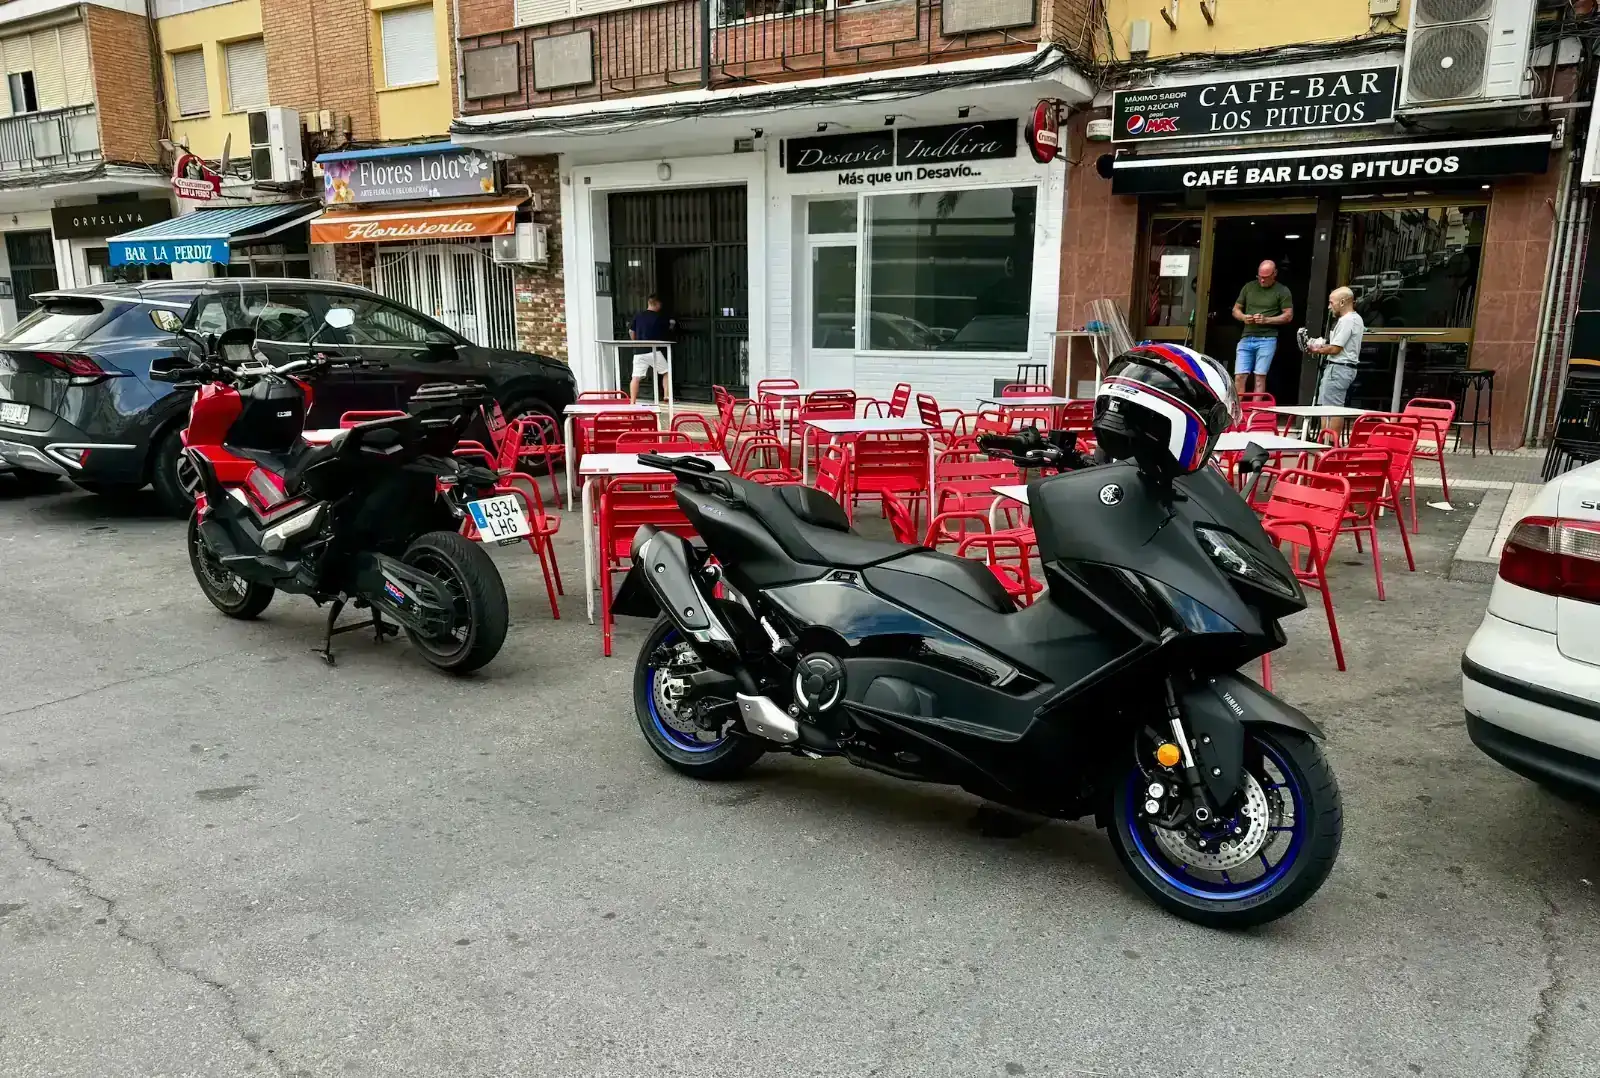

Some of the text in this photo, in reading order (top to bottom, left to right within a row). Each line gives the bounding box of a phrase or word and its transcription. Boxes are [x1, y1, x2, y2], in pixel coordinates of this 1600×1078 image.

[1124, 91, 1187, 103] MÁXIMO SABOR
[1199, 72, 1382, 107] CAFE-BAR
[1124, 102, 1180, 113] ZERO AZÚCAR
[1209, 101, 1365, 132] LOS PITUFOS
[1144, 116, 1180, 133] MAX
[796, 124, 1002, 167] Desavío Indhira
[360, 154, 460, 186] Flores Lola
[838, 164, 982, 187] Más que un Desavío...
[1182, 155, 1460, 188] CAFÉ BAR LOS PITUFOS
[177, 179, 211, 189] Cruzcampo
[373, 187, 392, 196] FLORAL
[73, 213, 143, 227] ORYSLAVA
[345, 219, 476, 239] Floristería
[125, 244, 212, 261] BAR LA PERDIZ
[483, 499, 519, 519] 4934
[488, 517, 518, 537] LHG
[1223, 692, 1244, 716] YAMAHA
